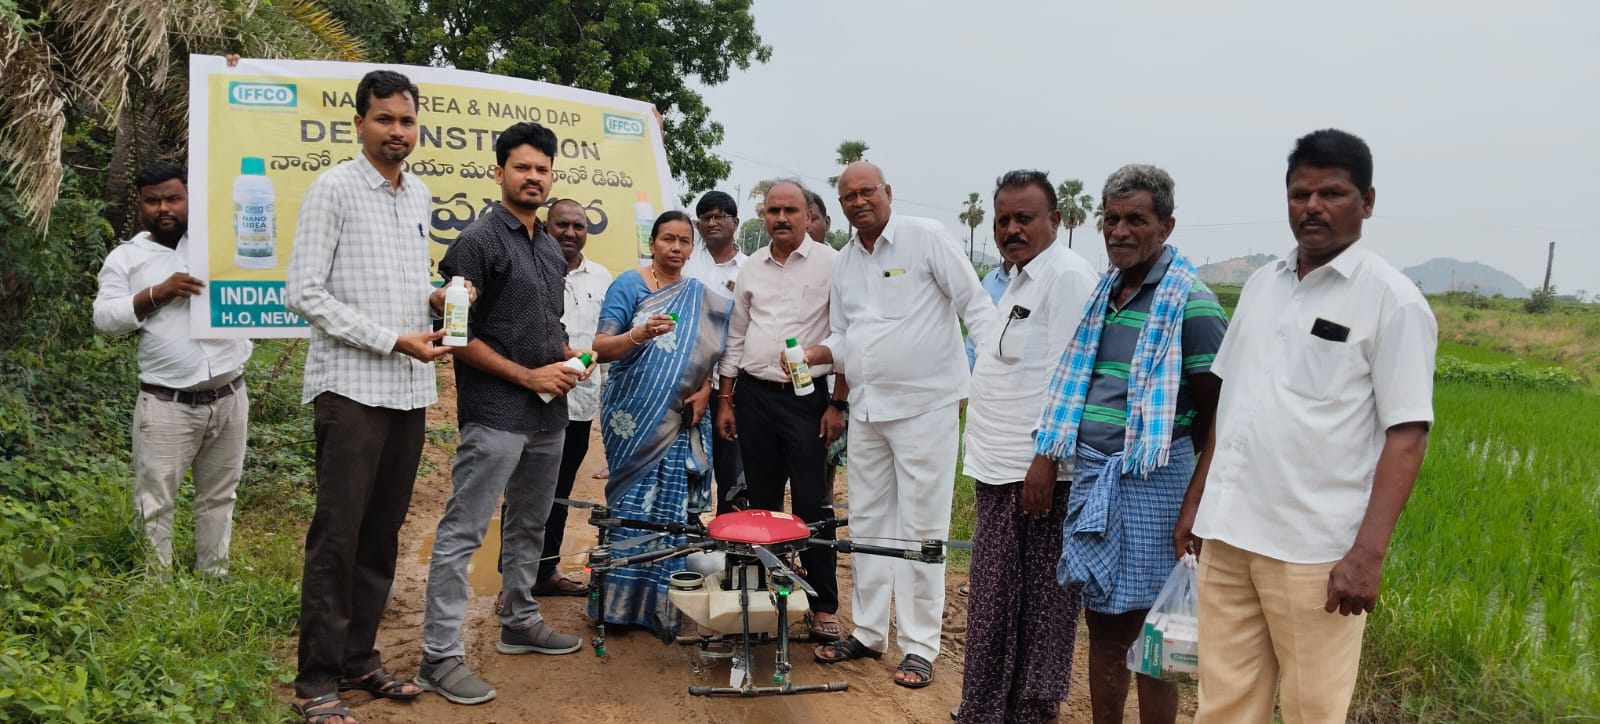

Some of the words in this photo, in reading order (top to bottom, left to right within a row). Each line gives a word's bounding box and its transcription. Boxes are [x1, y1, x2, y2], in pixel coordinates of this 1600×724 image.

[238, 87, 287, 102] IFFCO
[322, 91, 357, 108] NA
[418, 95, 461, 114] REA
[467, 99, 481, 115] &
[488, 102, 541, 122] NANO
[547, 110, 581, 127] DAP
[609, 118, 640, 132] IFFCO
[270, 150, 331, 172] నానో
[222, 311, 256, 326] H.O,
[260, 311, 299, 325] NEW
